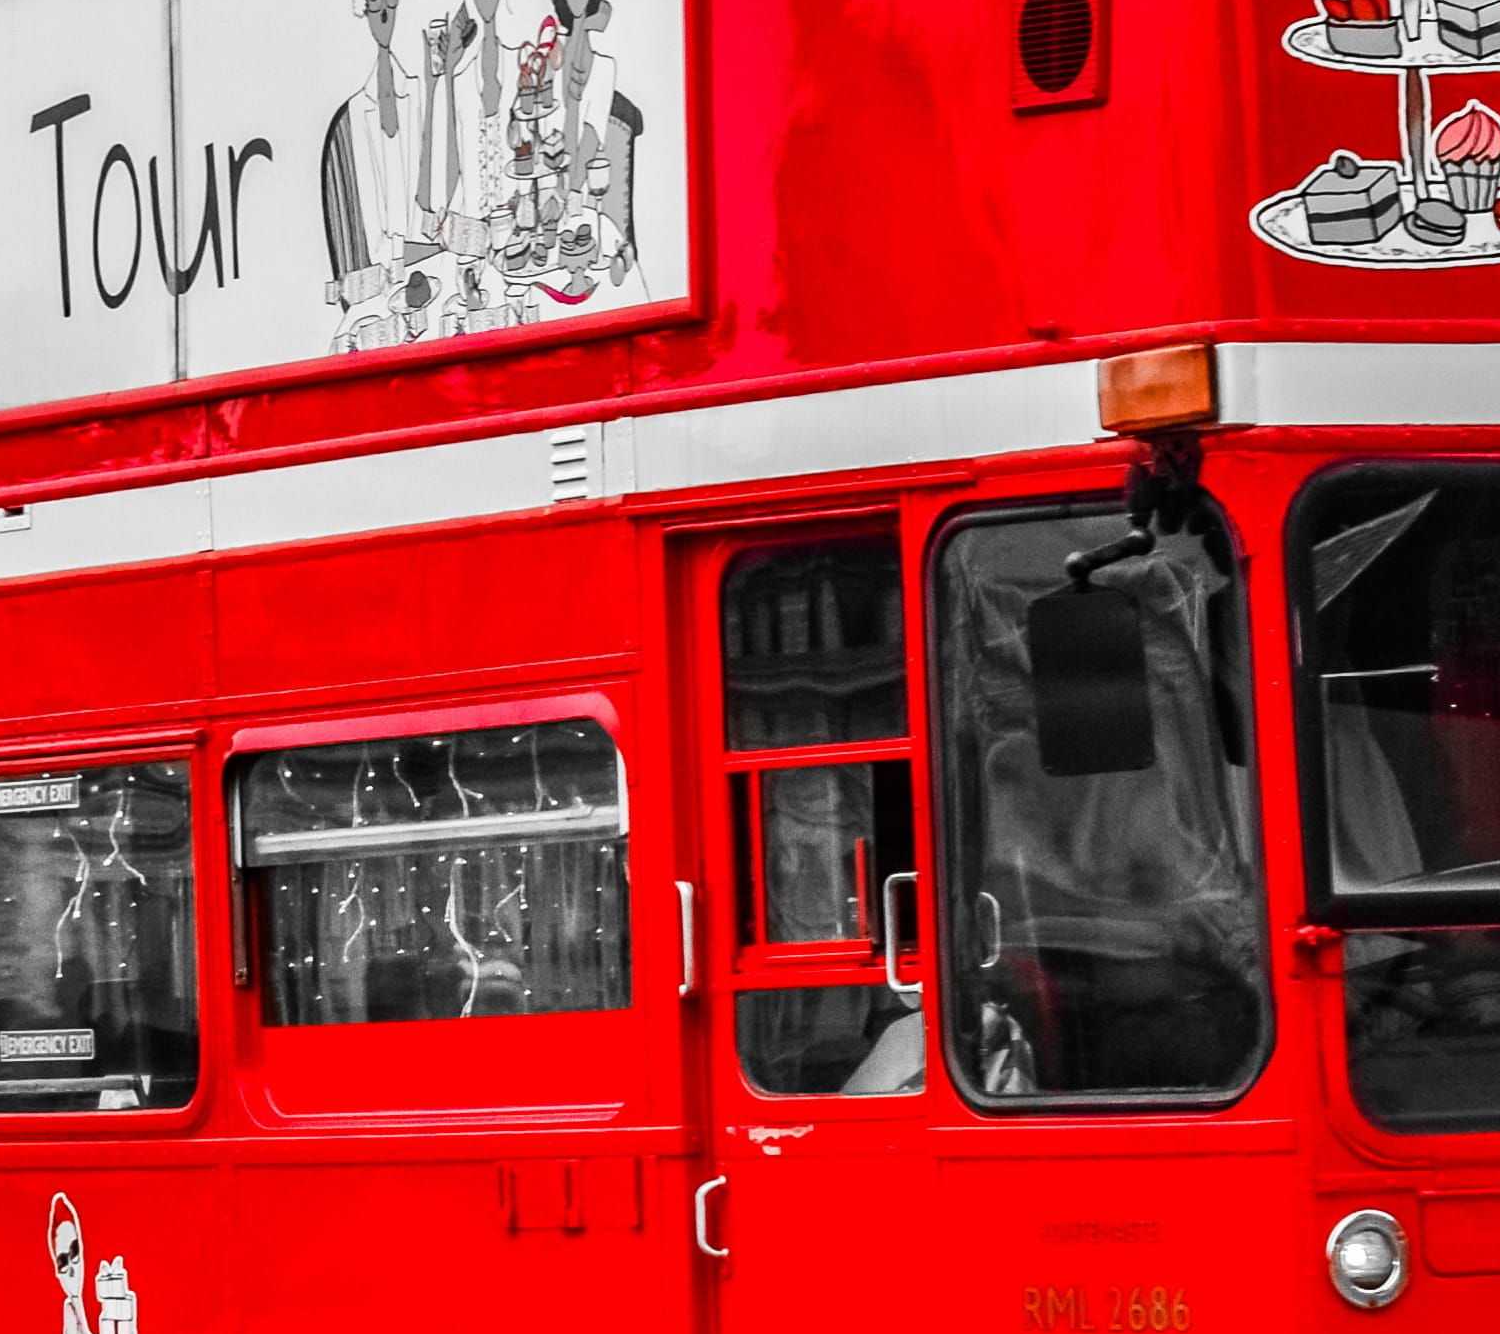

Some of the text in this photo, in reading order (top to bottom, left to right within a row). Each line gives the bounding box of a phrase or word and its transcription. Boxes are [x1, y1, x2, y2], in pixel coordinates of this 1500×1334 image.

[29, 93, 273, 318] Tour
[49, 783, 73, 803] EXIT
[1022, 1285, 1190, 1332] RML 2686
